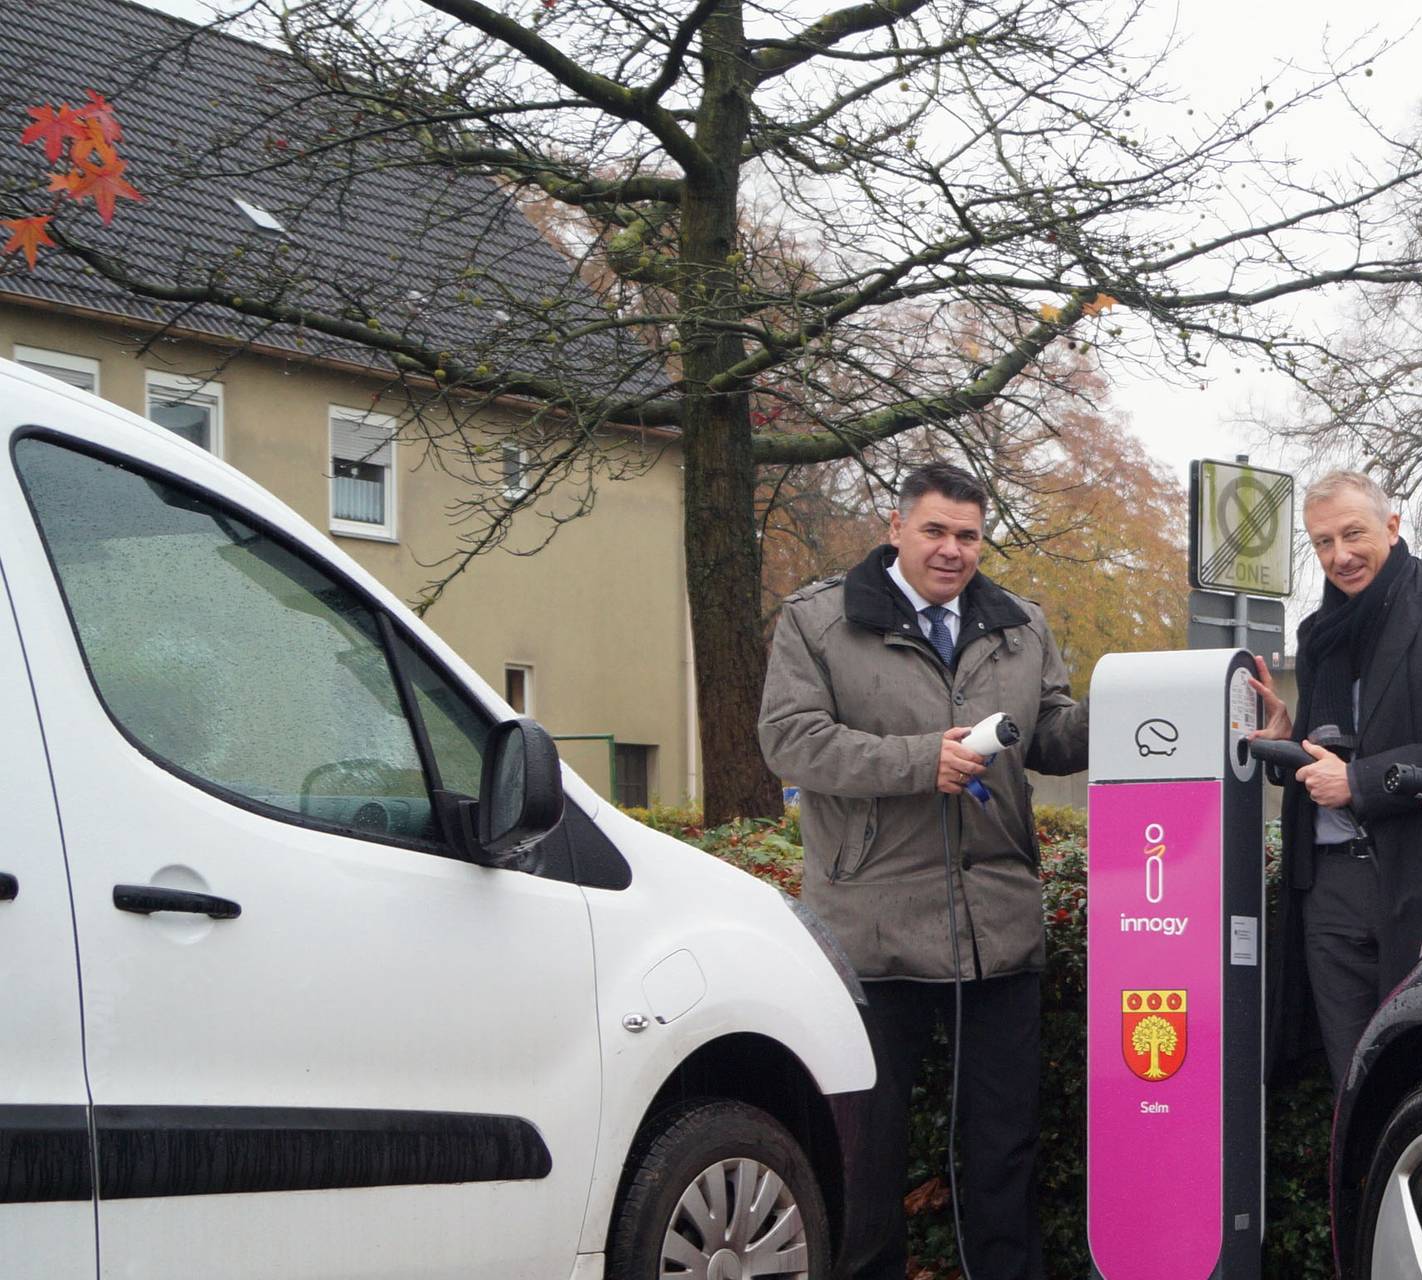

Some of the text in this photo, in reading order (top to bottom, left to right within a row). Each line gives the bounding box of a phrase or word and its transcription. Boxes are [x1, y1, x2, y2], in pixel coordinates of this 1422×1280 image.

[1225, 562, 1270, 585] ZONE
[1120, 912, 1189, 936] innogy
[1140, 1101, 1170, 1114] Selm
